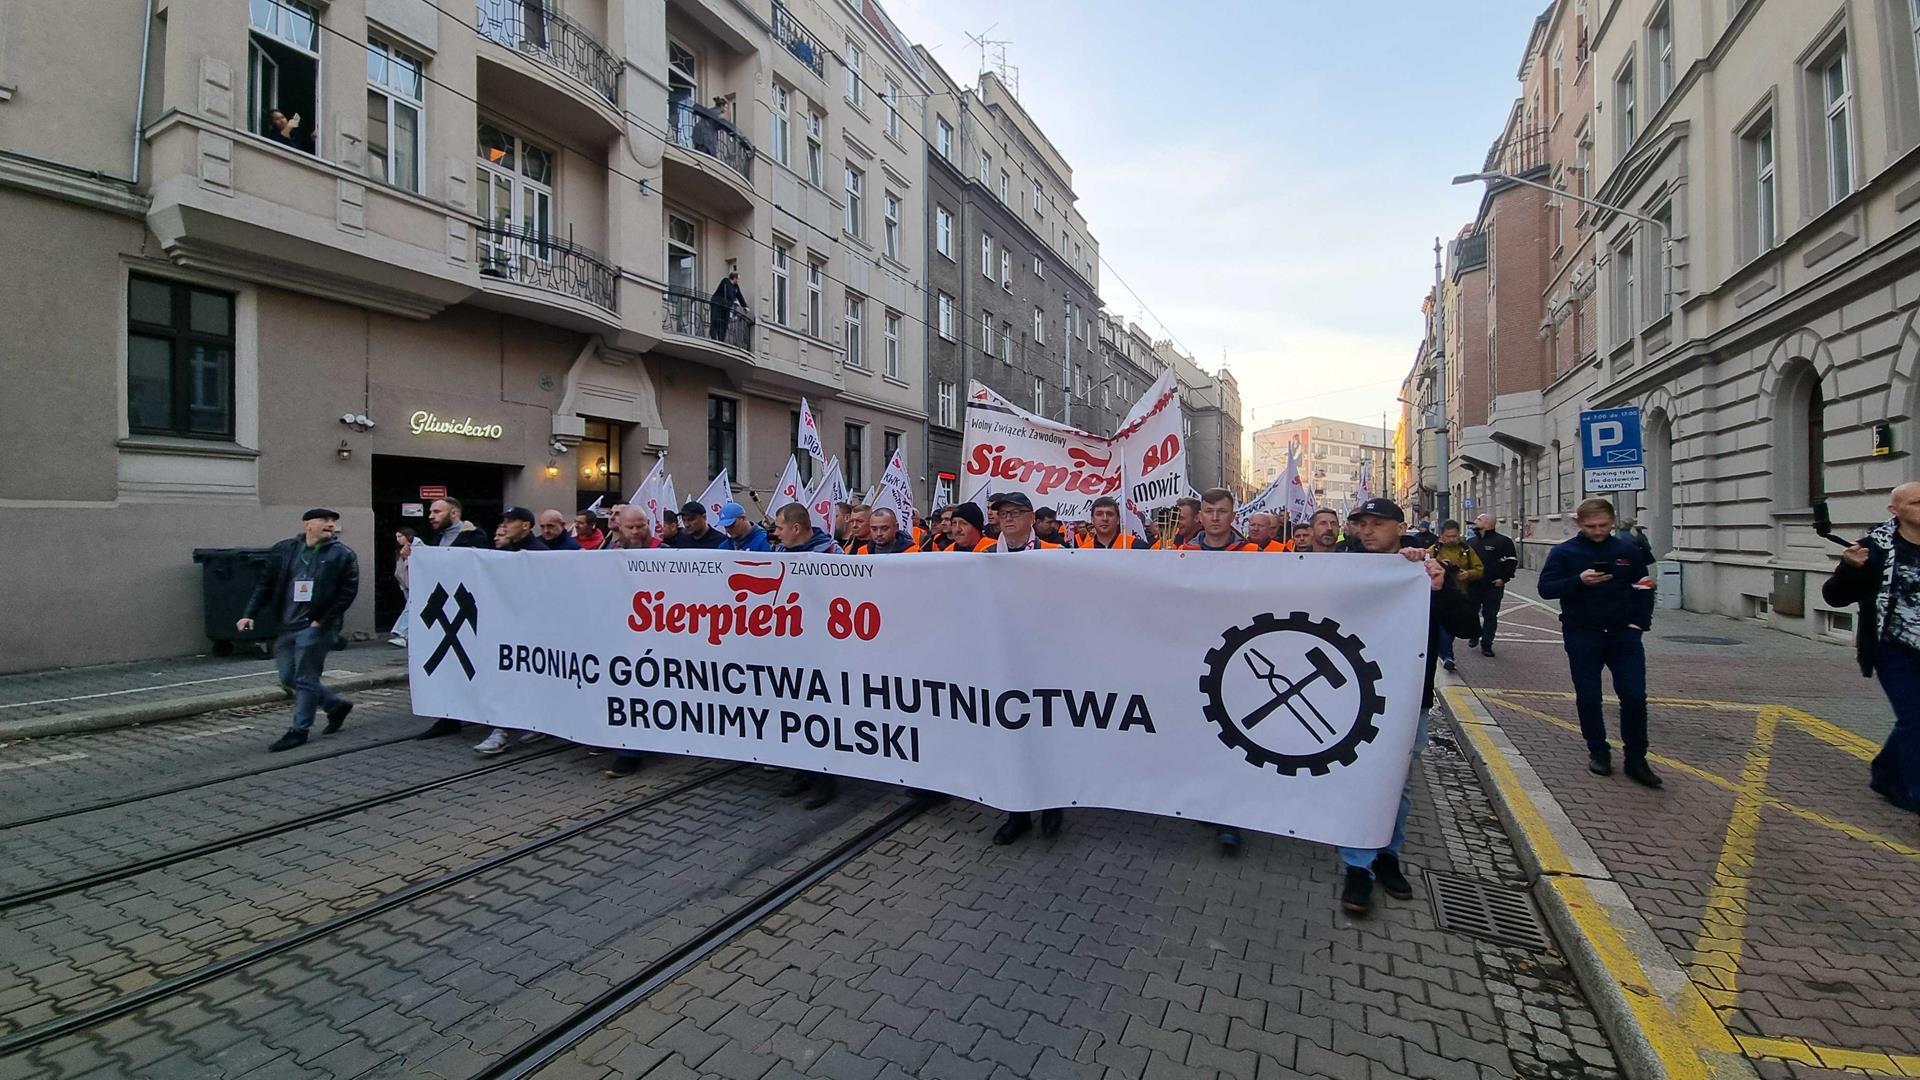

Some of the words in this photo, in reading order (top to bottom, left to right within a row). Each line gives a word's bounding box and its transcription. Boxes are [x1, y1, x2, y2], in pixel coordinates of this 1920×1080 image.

[971, 418, 993, 433] Wolny
[994, 421, 1026, 438] Związek
[1028, 428, 1067, 449] Zawodowy
[1591, 421, 1623, 457] P
[966, 443, 1121, 495] Sierpień
[1142, 434, 1180, 476] 80
[628, 561, 667, 574] WOLNY
[668, 561, 724, 577] ZWIĄZEK
[789, 562, 874, 578] ZAWODOWY
[627, 591, 803, 645] Sierpień
[827, 597, 881, 641] 80
[498, 644, 600, 690] BRONIĄC
[608, 648, 832, 704] GÓRNICTWA
[840, 671, 850, 707] I
[862, 673, 1157, 734] HUTNICTWA
[607, 696, 770, 741] BRONIMY
[779, 710, 920, 763] POLSKI
